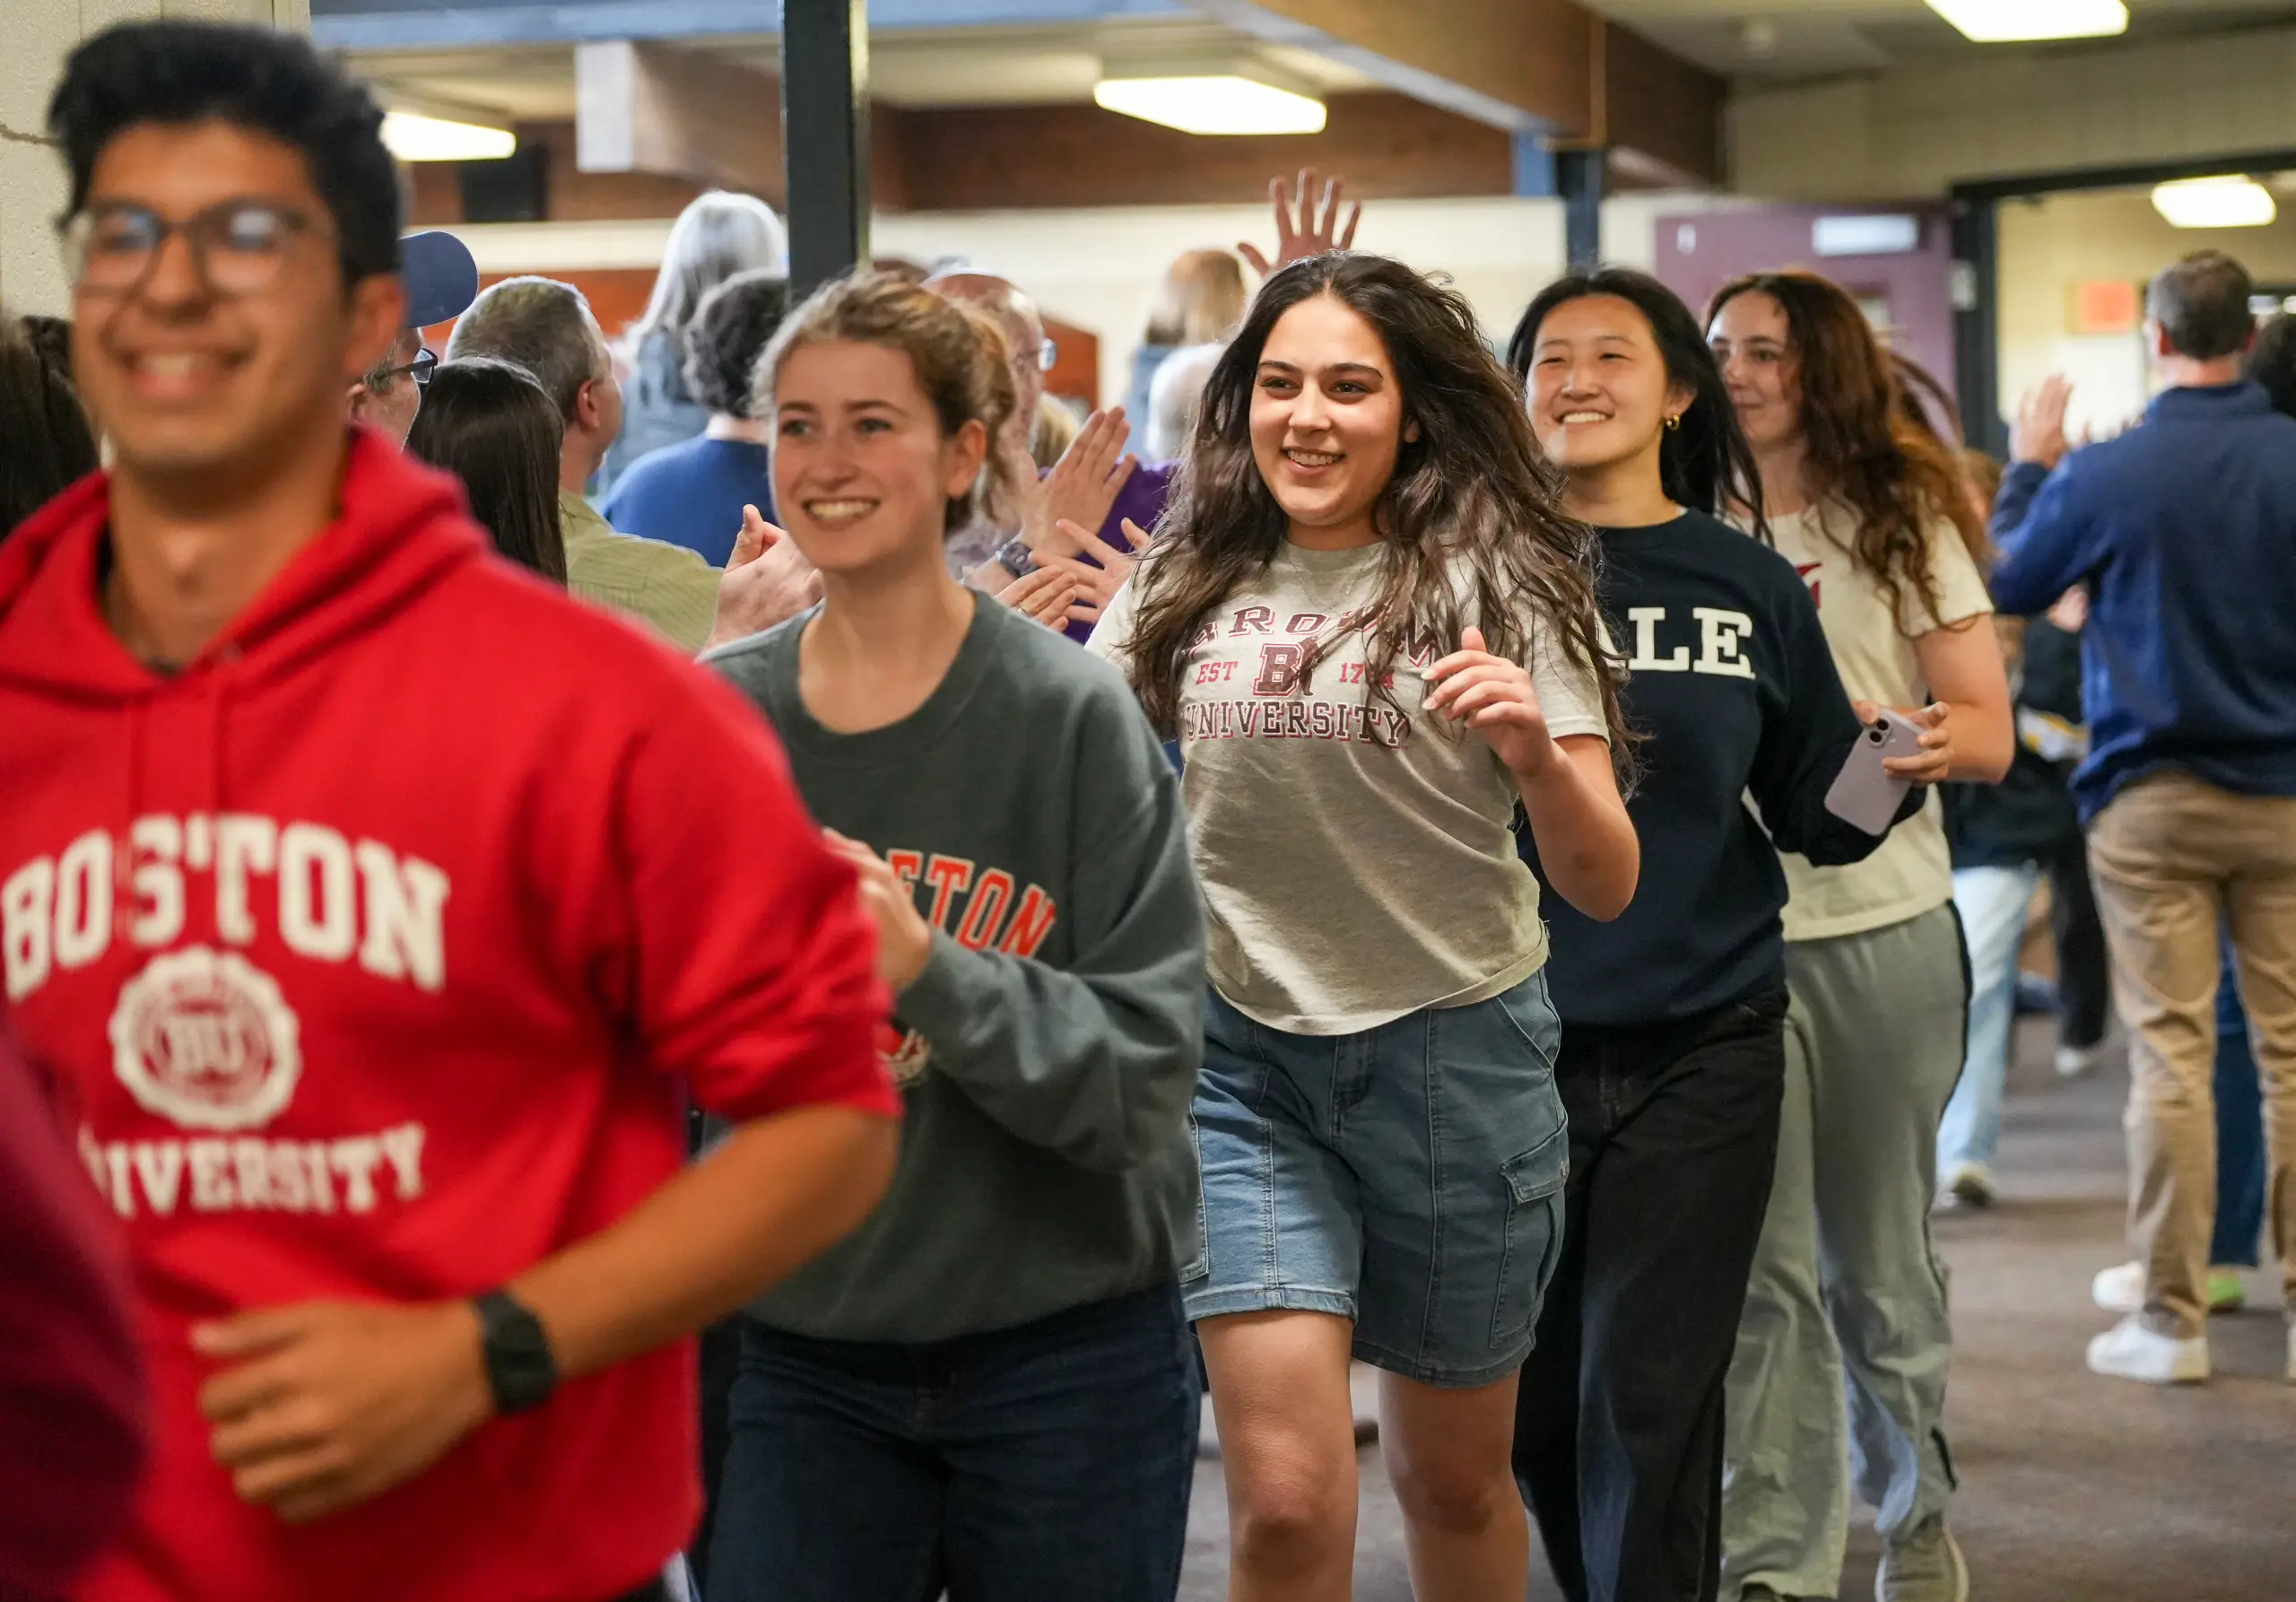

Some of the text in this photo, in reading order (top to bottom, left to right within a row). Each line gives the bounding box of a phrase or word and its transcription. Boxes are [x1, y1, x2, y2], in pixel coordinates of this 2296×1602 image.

[1195, 660, 1238, 685] EST
[1184, 700, 1413, 750] UNIVERSITY
[1, 810, 451, 996] BOSTON
